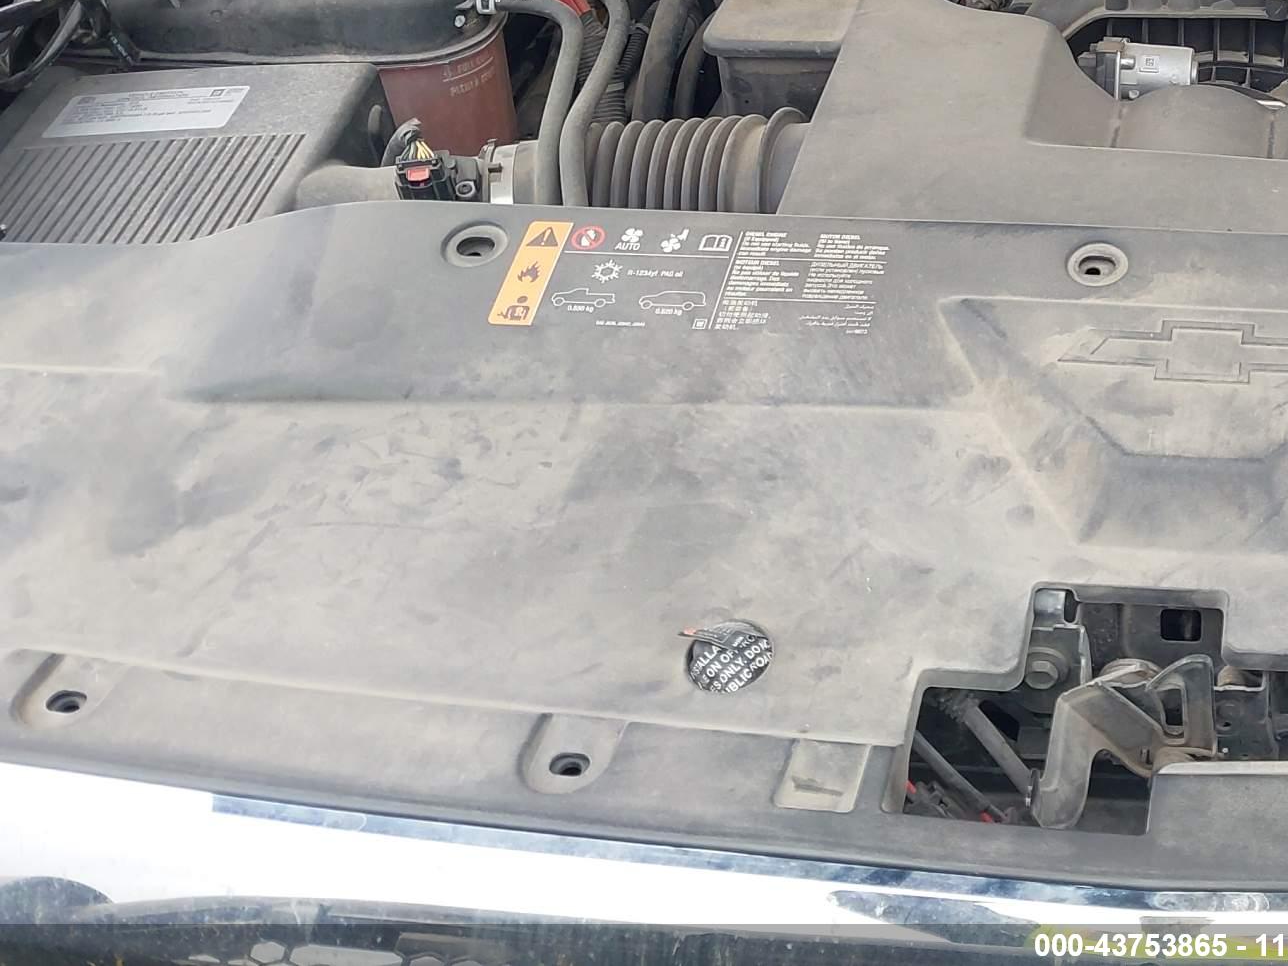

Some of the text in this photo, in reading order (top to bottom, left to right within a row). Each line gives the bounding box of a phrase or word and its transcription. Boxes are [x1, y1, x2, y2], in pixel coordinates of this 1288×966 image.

[614, 242, 641, 251] AUTO
[706, 661, 722, 678] ON
[719, 657, 748, 683] ONLY.
[744, 643, 761, 660] DO
